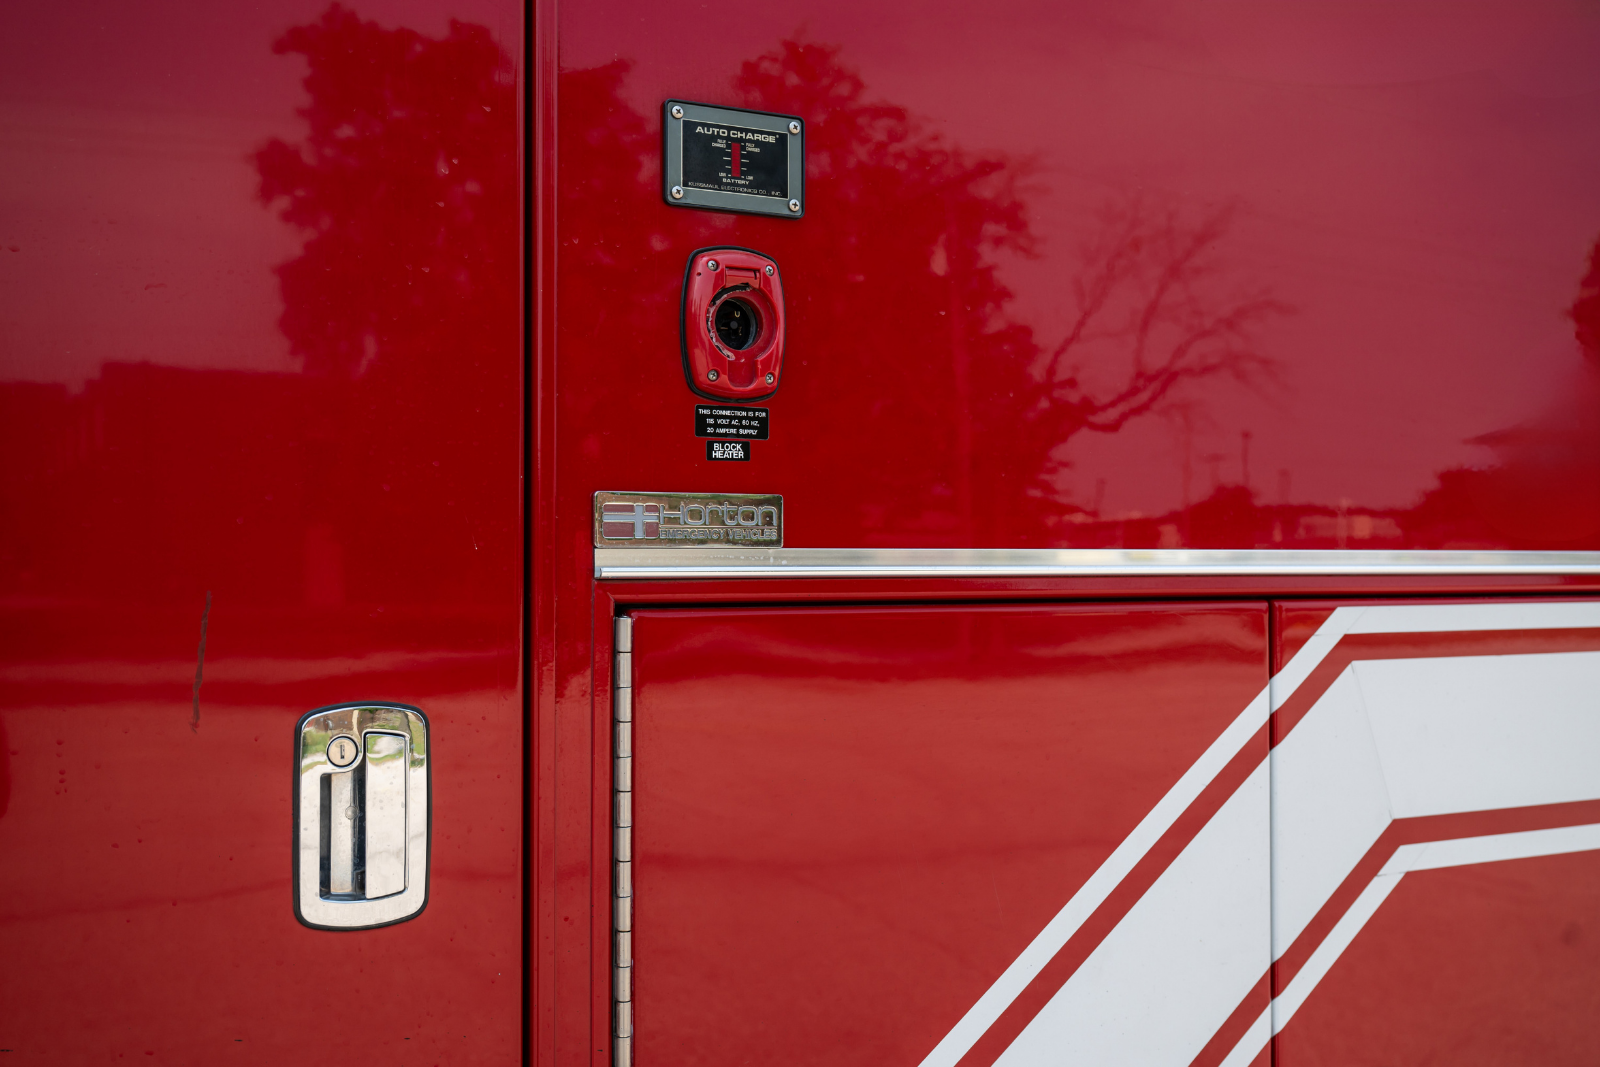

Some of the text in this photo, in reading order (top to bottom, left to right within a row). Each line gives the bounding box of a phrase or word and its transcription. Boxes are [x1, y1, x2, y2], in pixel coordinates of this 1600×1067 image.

[695, 126, 728, 136] AUTO
[688, 181, 719, 189] KUSSMAUL
[721, 185, 758, 194] ELECTRONICS
[712, 409, 747, 417] CONNECTION
[713, 443, 743, 451] BLOCK
[712, 450, 745, 459] HEATER
[659, 501, 778, 526] Horton
[659, 528, 778, 540] EMERGENCY VEHICLES
